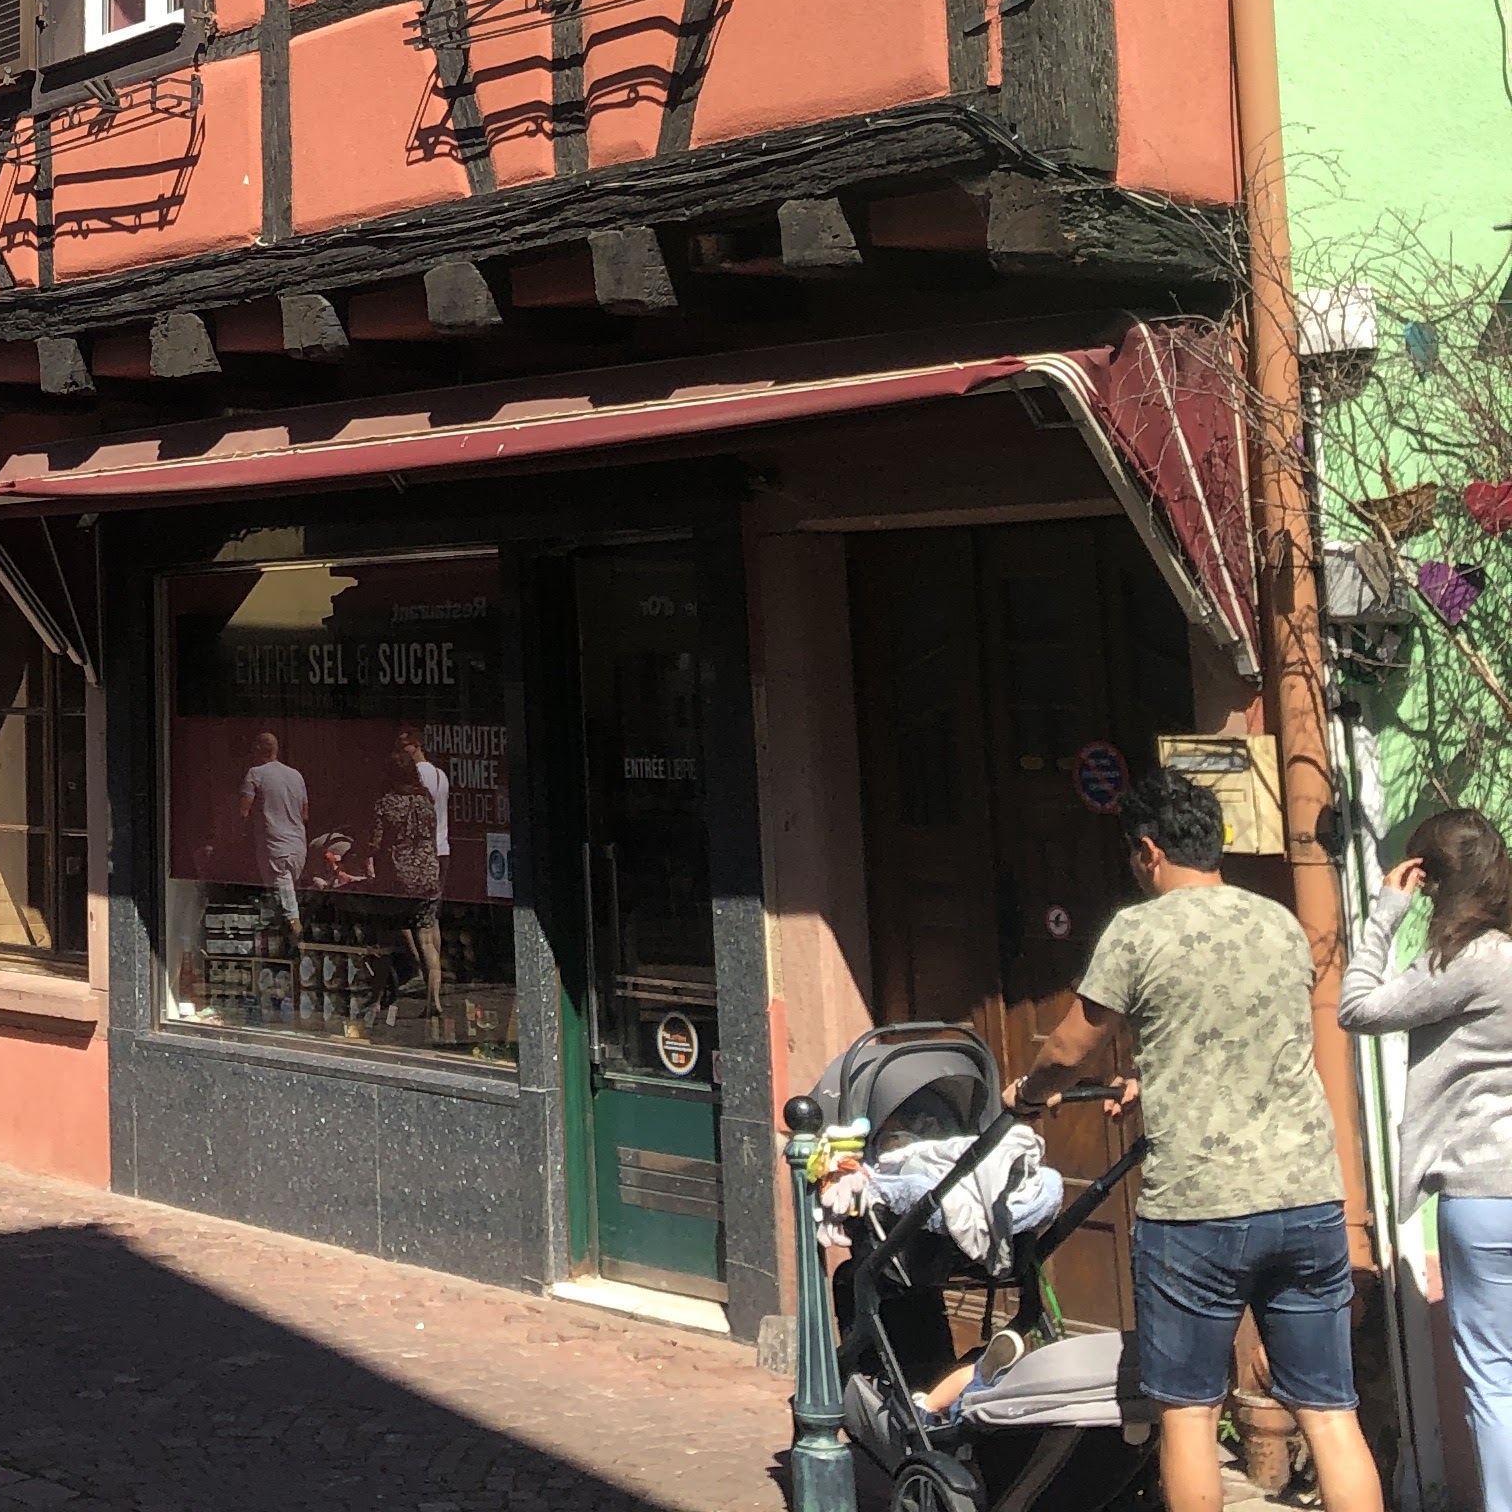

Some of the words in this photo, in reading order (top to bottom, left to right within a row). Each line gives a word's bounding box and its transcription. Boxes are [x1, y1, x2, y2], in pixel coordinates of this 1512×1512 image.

[235, 644, 300, 684] ENTRE
[308, 643, 348, 685] SEL
[378, 642, 456, 685] SUCRE
[624, 754, 665, 779] ENTRÉE
[475, 793, 493, 825] DE
